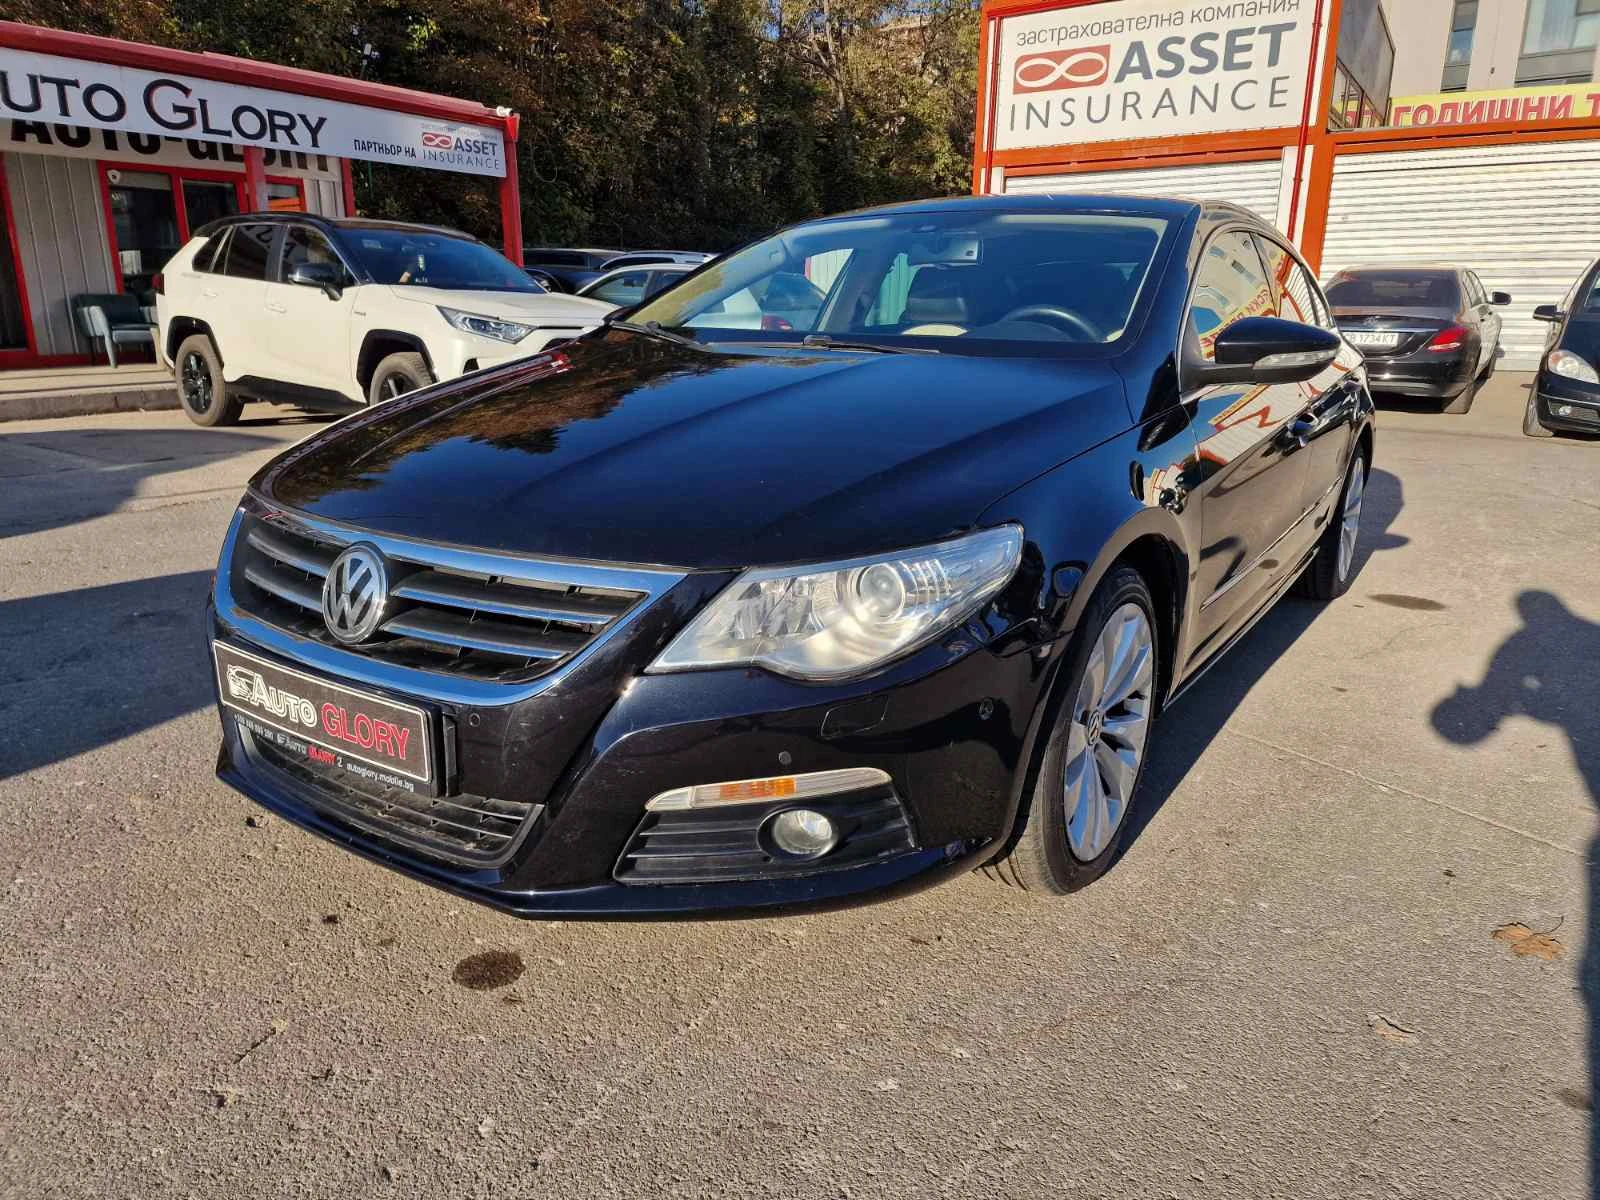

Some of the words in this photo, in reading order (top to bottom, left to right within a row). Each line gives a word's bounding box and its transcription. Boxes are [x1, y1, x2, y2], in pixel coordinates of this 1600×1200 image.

[1016, 10, 1184, 47] застрахователна
[1190, 0, 1301, 26] компания
[1114, 22, 1297, 83] ASSET
[0, 70, 127, 122] UTO
[143, 78, 328, 148] GLORY
[1009, 75, 1290, 131] INSURANCE
[1392, 94, 1574, 127] ГОДИШНИ
[354, 139, 402, 156] ПАРТНЬОР
[404, 147, 417, 159] НА
[423, 149, 500, 170] INSURANCE
[454, 137, 498, 156] ASSET
[250, 672, 317, 728] AUTO
[321, 703, 410, 760] GLORY
